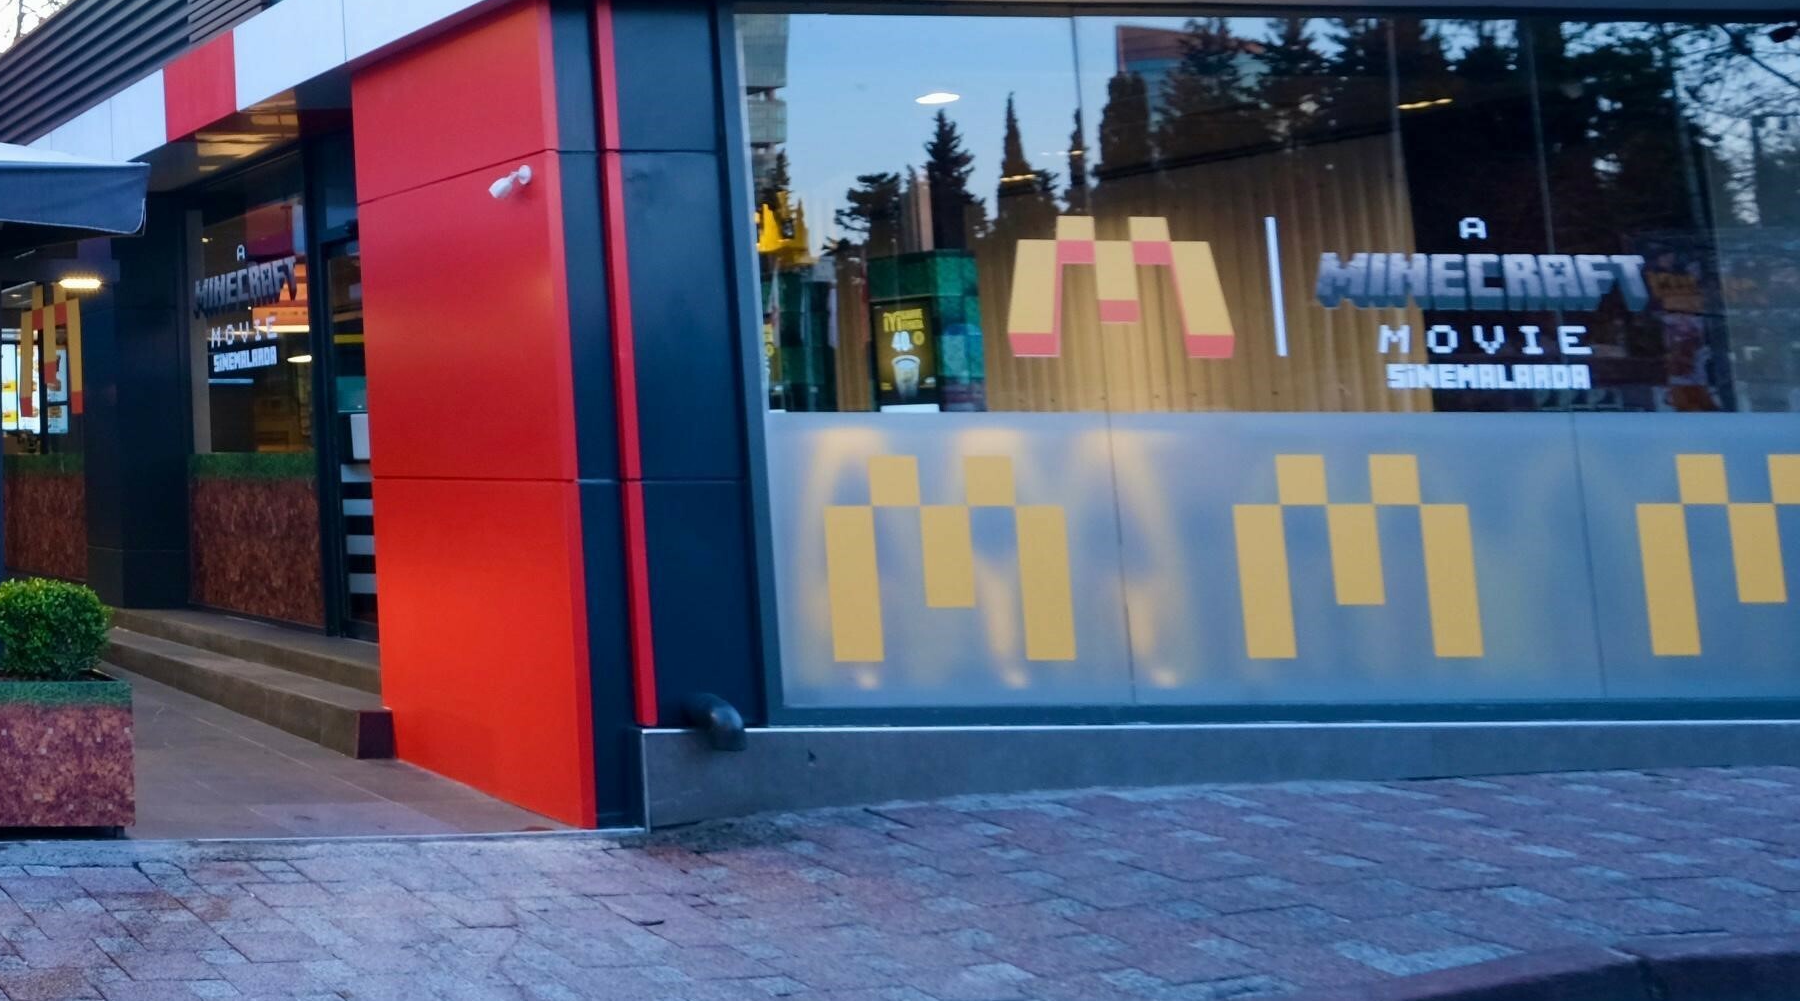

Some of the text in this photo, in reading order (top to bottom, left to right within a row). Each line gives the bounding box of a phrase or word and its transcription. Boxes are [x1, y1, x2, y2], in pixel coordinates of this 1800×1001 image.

[1458, 217, 1488, 240] A
[236, 244, 246, 262] A
[194, 255, 297, 315] MINECRAFT
[1315, 252, 1651, 312] MINECRAFT
[210, 315, 278, 349] MOVIE
[1377, 324, 1594, 356] MOVIE
